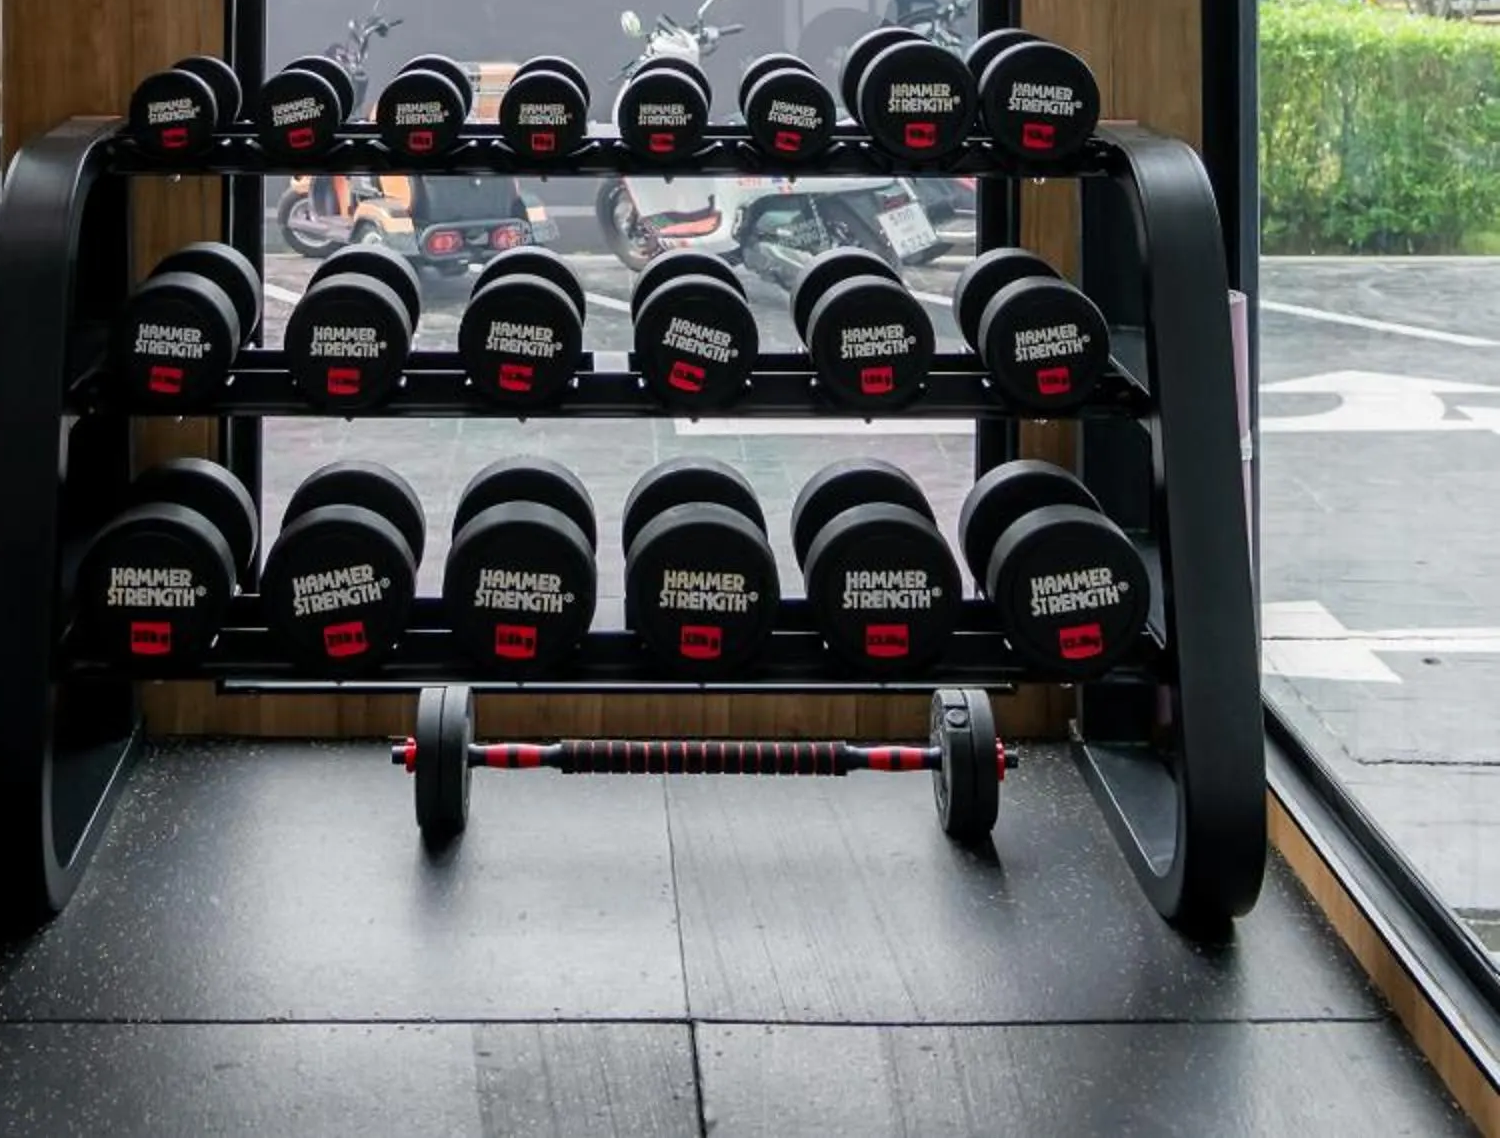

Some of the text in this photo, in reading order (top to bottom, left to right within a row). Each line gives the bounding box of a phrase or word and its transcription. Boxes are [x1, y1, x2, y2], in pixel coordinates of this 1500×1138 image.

[890, 83, 951, 98] HAMMER
[1011, 82, 1073, 101] HAMMER
[139, 323, 202, 343] HAMMER
[313, 326, 376, 342] HAMMER
[489, 321, 553, 343] HAMMER
[669, 318, 731, 344] HAMMER
[842, 324, 904, 345] HAMMER
[1015, 324, 1078, 347] HAMMER
[111, 567, 192, 587] HAMMER
[292, 564, 375, 597] HAMMER
[479, 568, 561, 593] HAMMER
[663, 570, 745, 592] HAMMER
[846, 570, 927, 590] HAMMER
[1031, 567, 1112, 597] HAMMER
